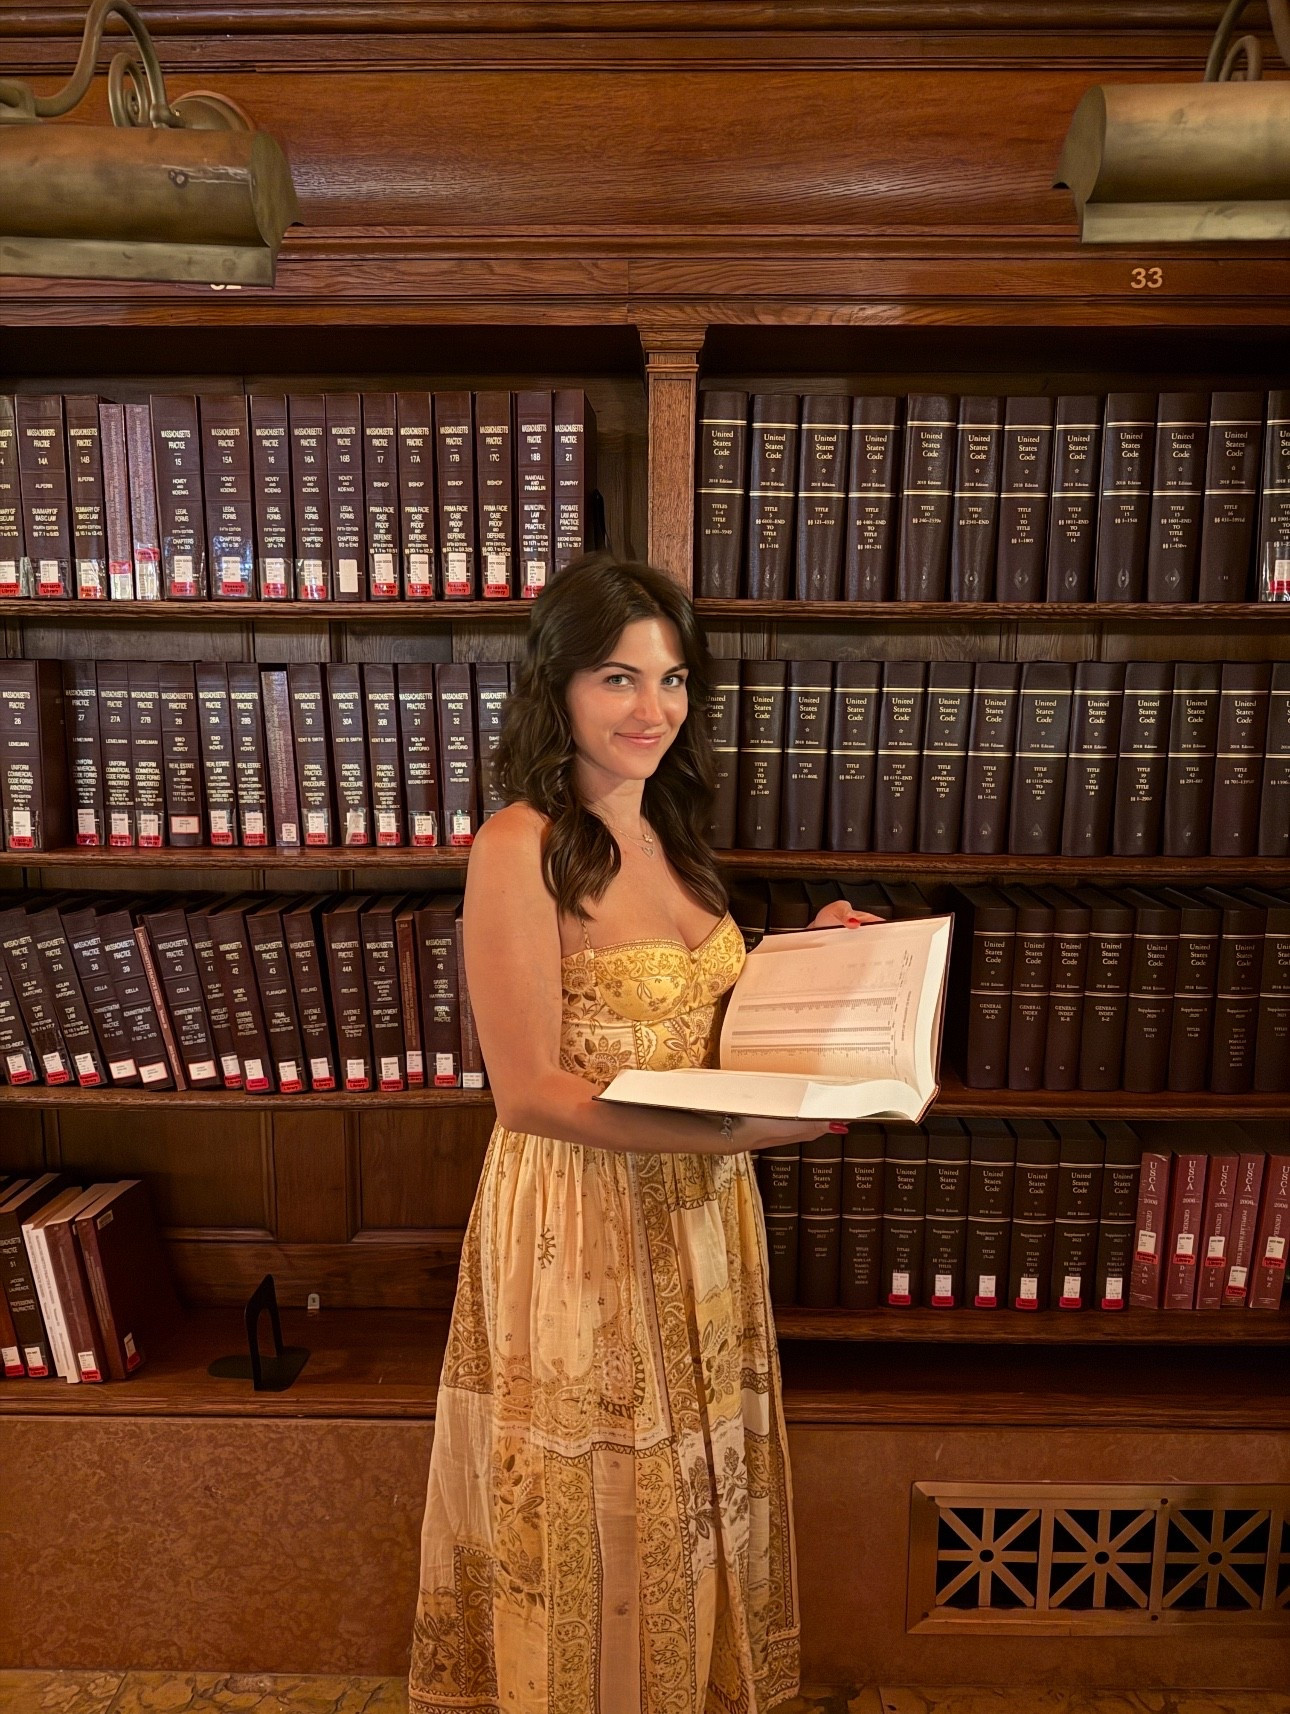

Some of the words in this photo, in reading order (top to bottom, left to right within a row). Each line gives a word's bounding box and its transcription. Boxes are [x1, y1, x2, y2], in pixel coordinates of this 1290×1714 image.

[1131, 267, 1162, 288] 33
[486, 437, 502, 445] PRACTICE
[713, 440, 731, 448] States
[764, 434, 785, 442] United
[765, 443, 783, 451] States
[766, 452, 782, 460] Code
[1025, 949, 1043, 957] States
[1148, 1162, 1157, 1191] USCA
[1187, 1161, 1196, 1190] USCA
[1219, 1166, 1228, 1194] USCA
[1244, 1163, 1255, 1192] USCA
[1279, 1166, 1290, 1195] USCA
